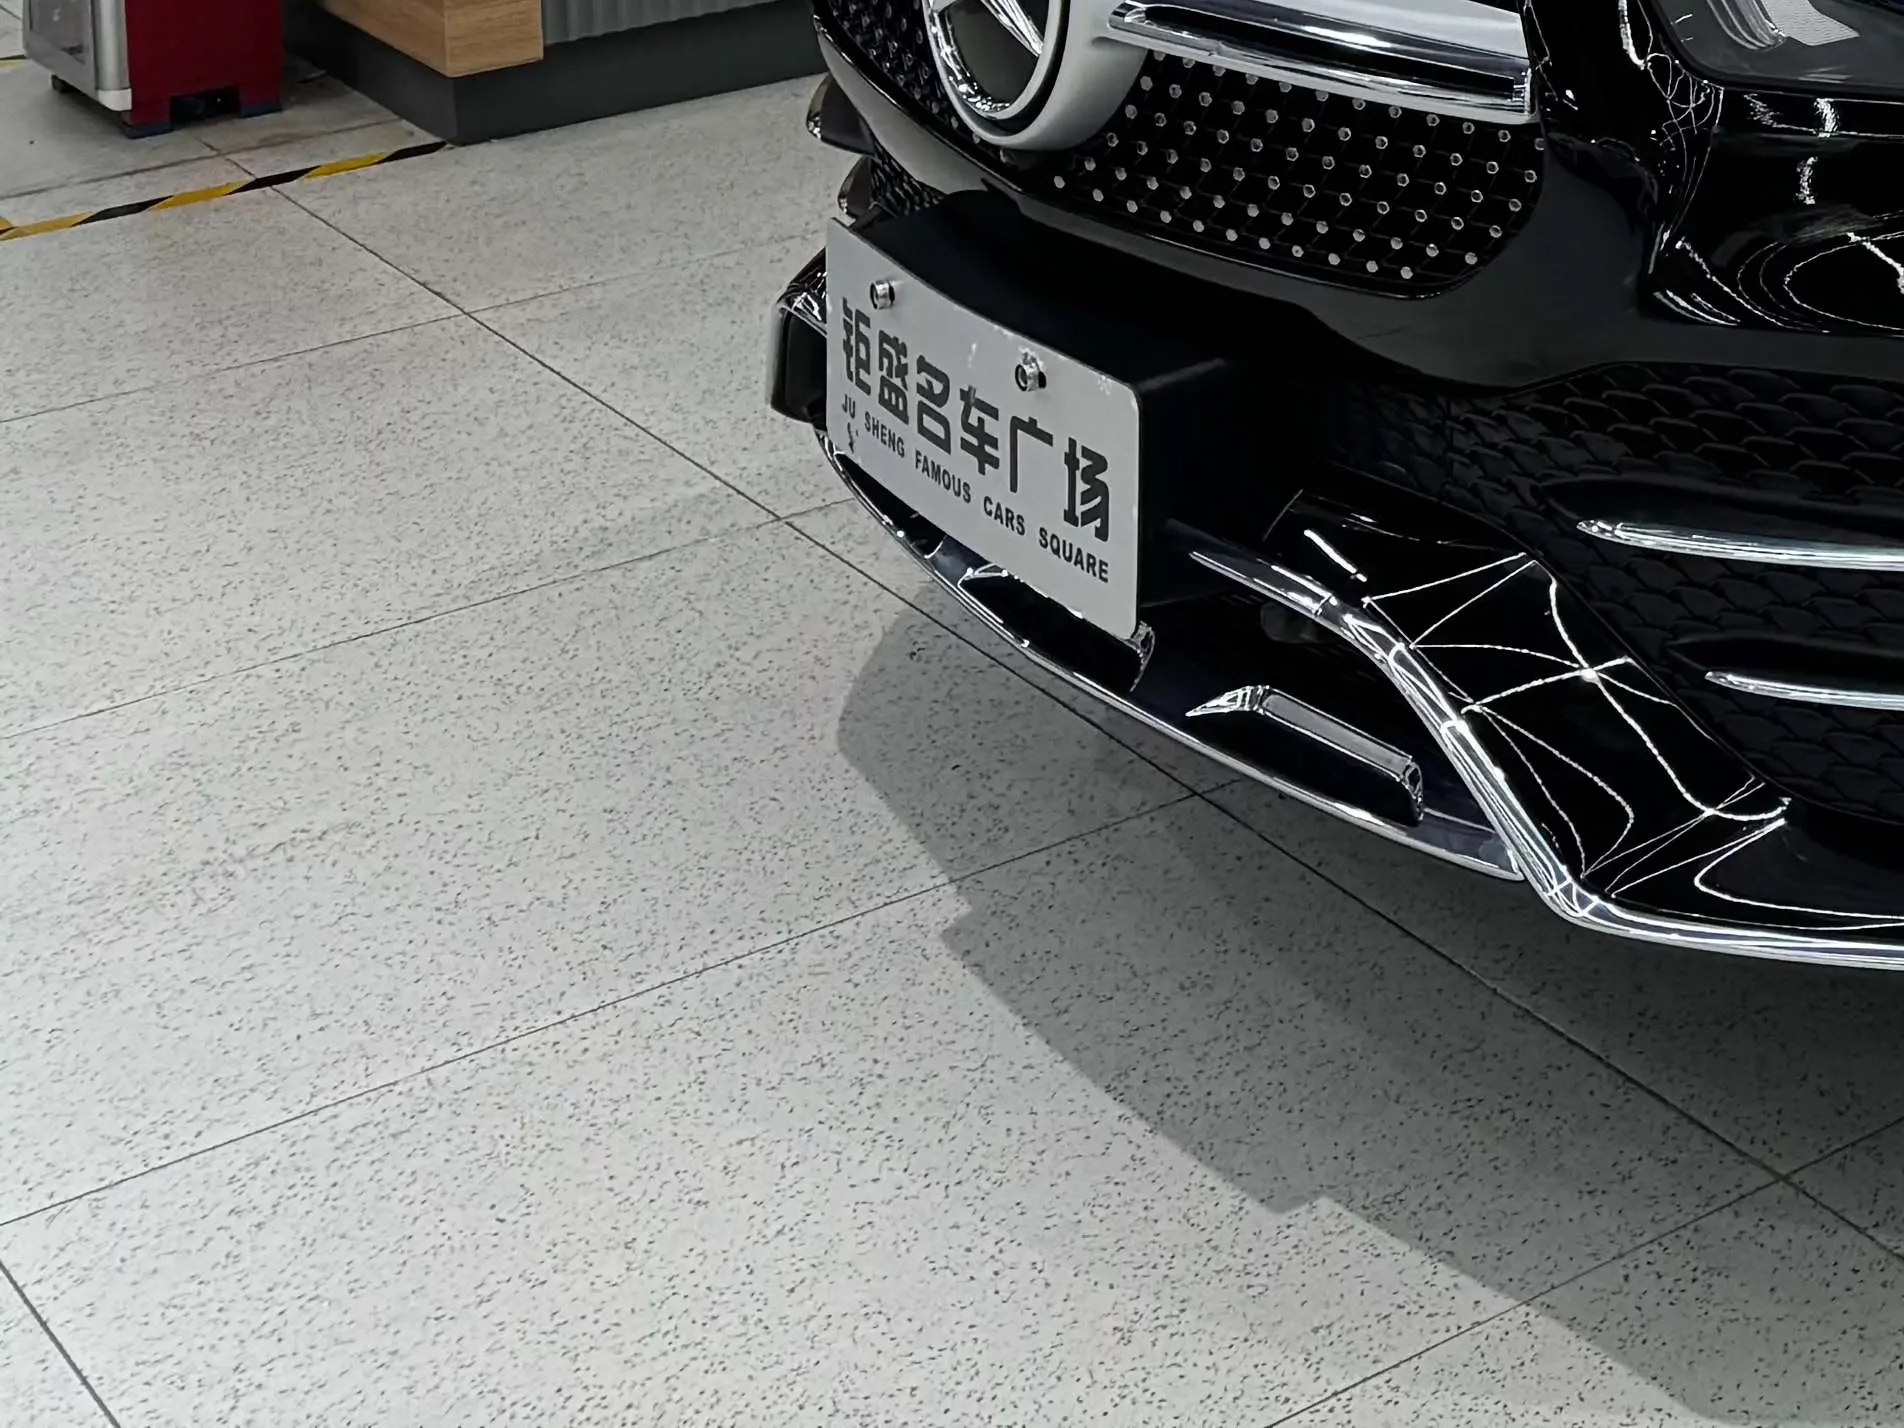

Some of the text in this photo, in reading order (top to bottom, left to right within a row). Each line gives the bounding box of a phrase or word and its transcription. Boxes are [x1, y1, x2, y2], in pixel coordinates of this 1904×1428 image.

[841, 394, 1109, 583] JU SHENG FAMOUS CARS SQUARE
[842, 296, 1110, 542] 钜盛名车广场
